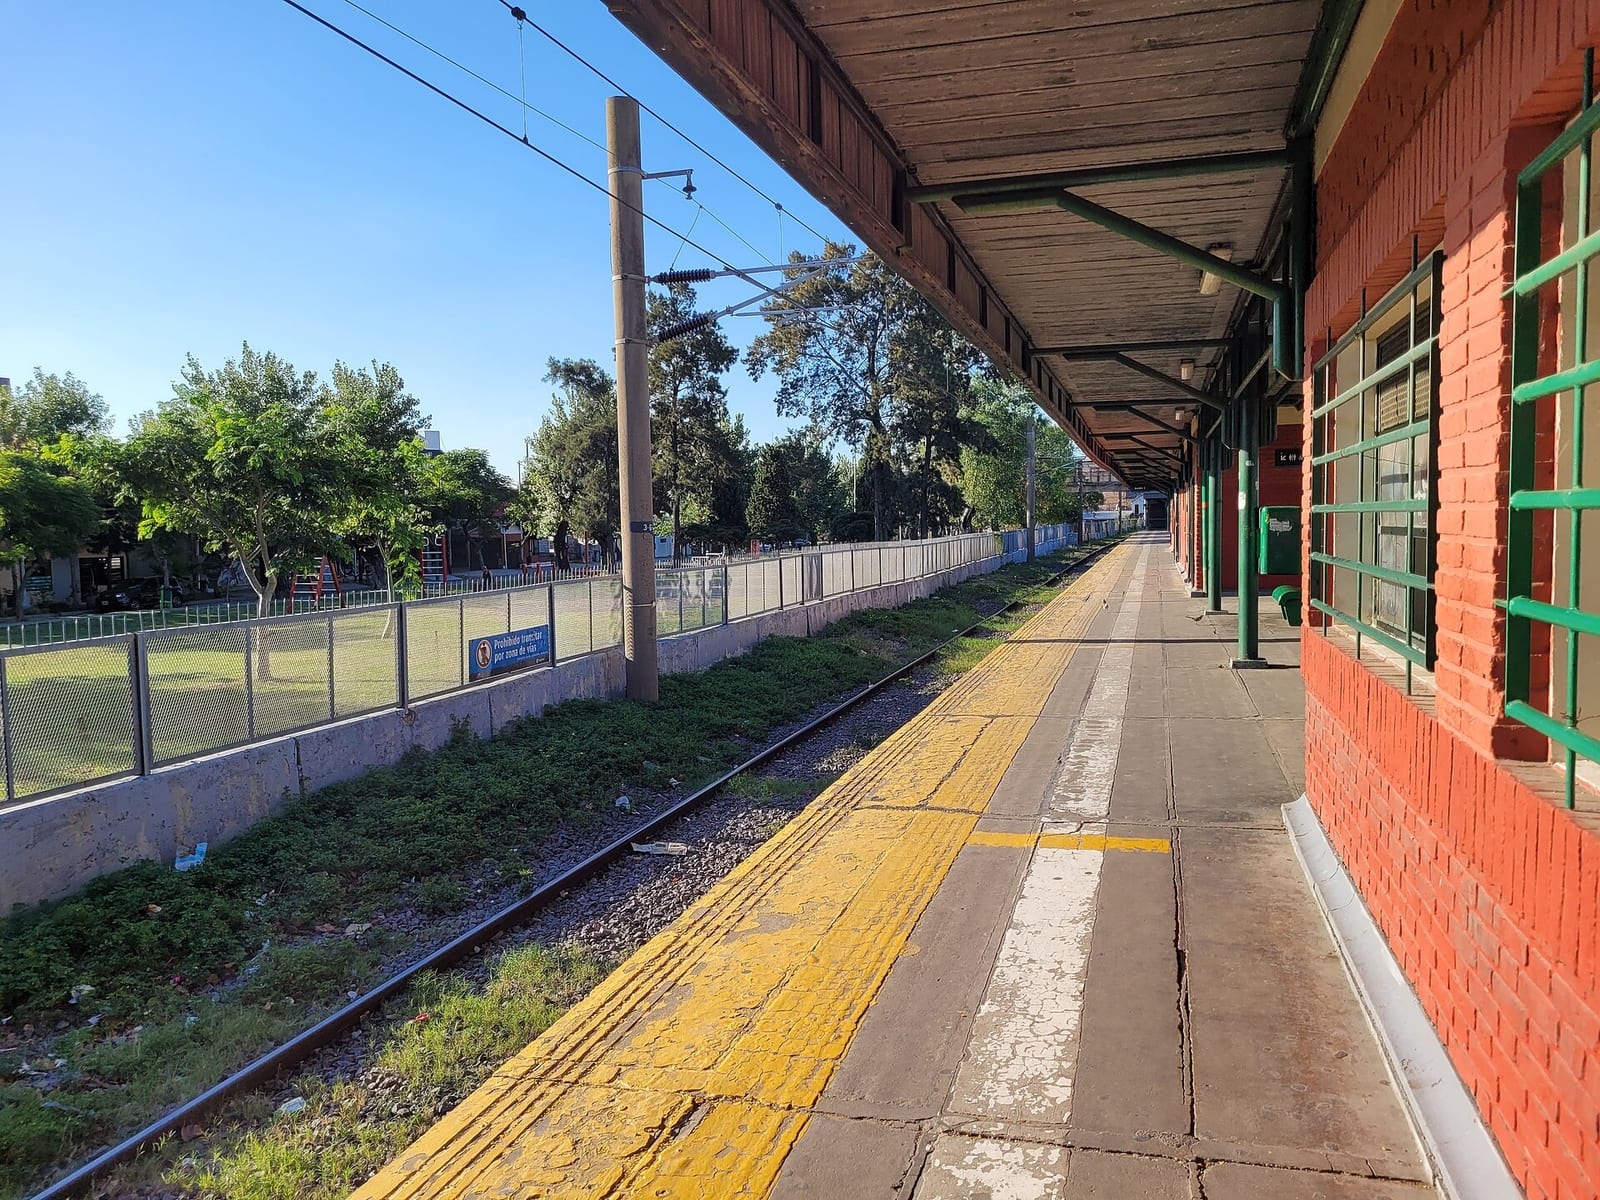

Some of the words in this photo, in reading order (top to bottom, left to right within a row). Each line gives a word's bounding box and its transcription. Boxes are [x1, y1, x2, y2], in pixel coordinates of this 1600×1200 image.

[494, 635, 520, 650] Prohibido
[521, 631, 542, 643] transitar
[494, 652, 504, 664] por
[505, 649, 518, 659] zona
[519, 645, 526, 656] de
[526, 643, 537, 654] vías
